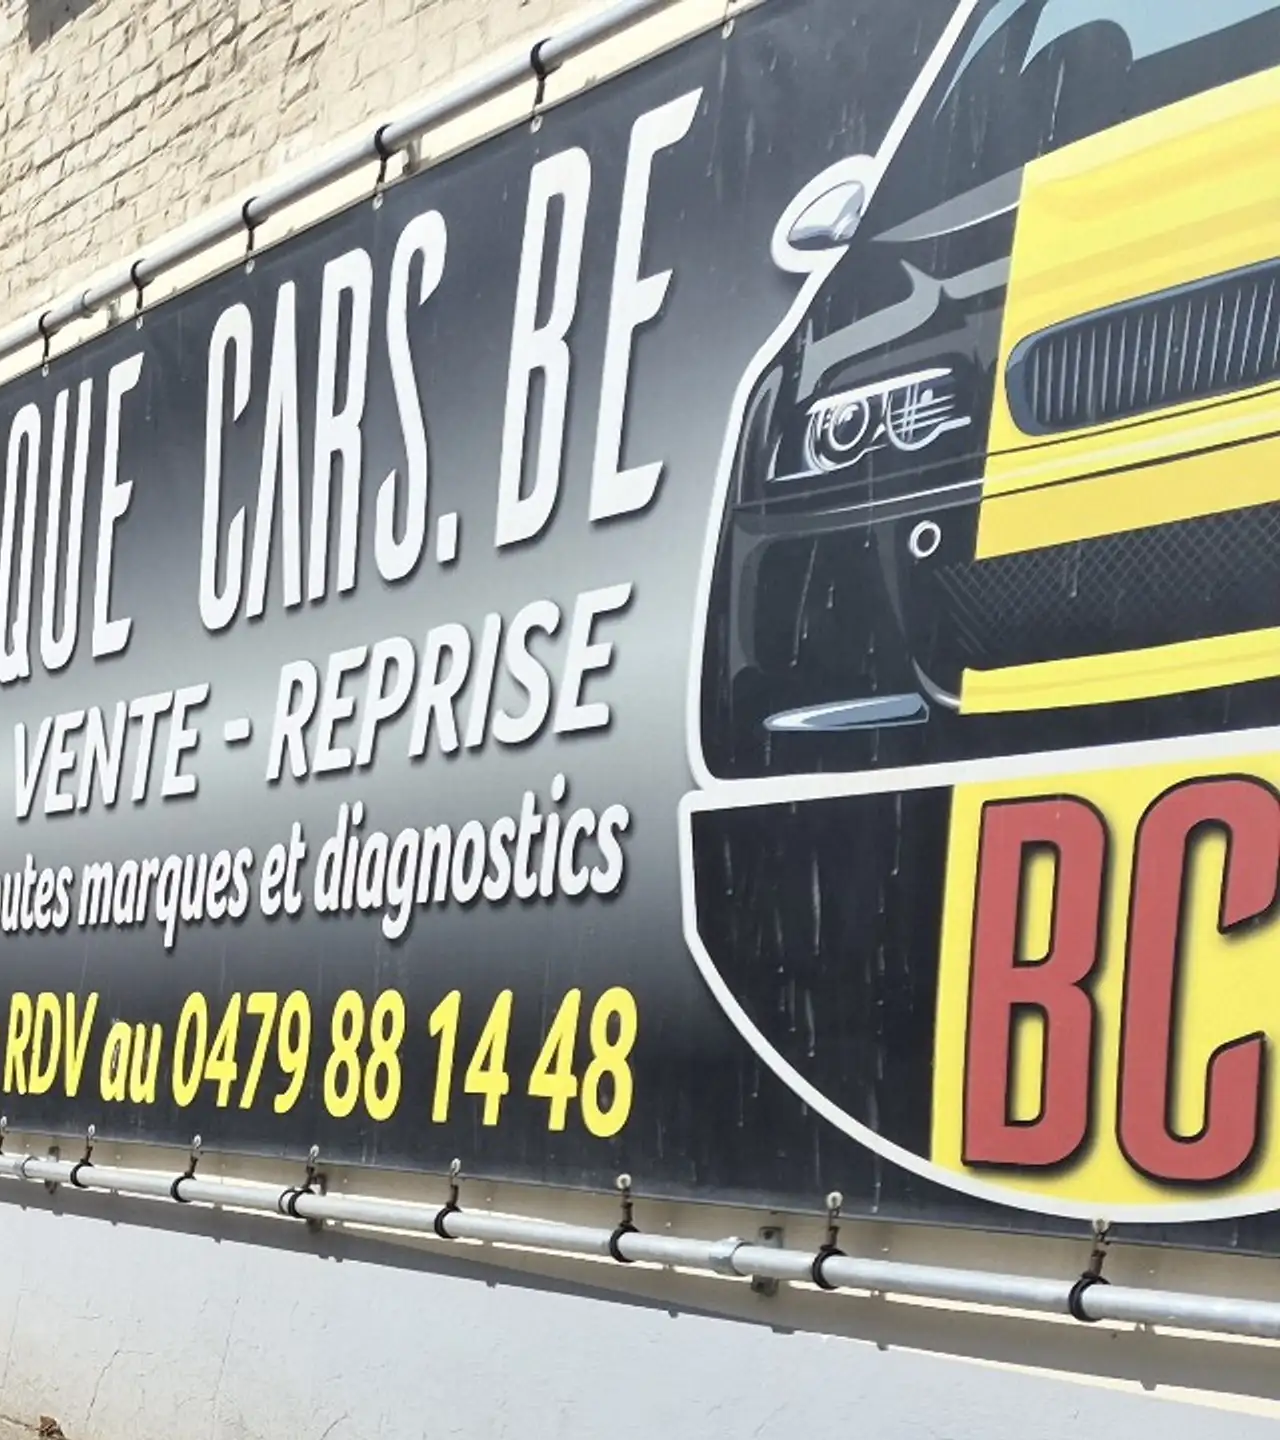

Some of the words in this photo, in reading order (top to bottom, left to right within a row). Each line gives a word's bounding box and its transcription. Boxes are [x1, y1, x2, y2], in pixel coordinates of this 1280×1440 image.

[12, 684, 211, 818] VENTE
[266, 583, 633, 781] REPRISE
[76, 843, 253, 948] marques
[259, 820, 304, 916] et
[313, 775, 630, 940] diagnostics
[3, 992, 98, 1100] RDV
[101, 1016, 164, 1103] au
[172, 990, 311, 1114] 0479
[324, 989, 407, 1121] 88
[427, 989, 509, 1126] 14
[528, 986, 637, 1138] 48
[960, 775, 1280, 1188] BC
